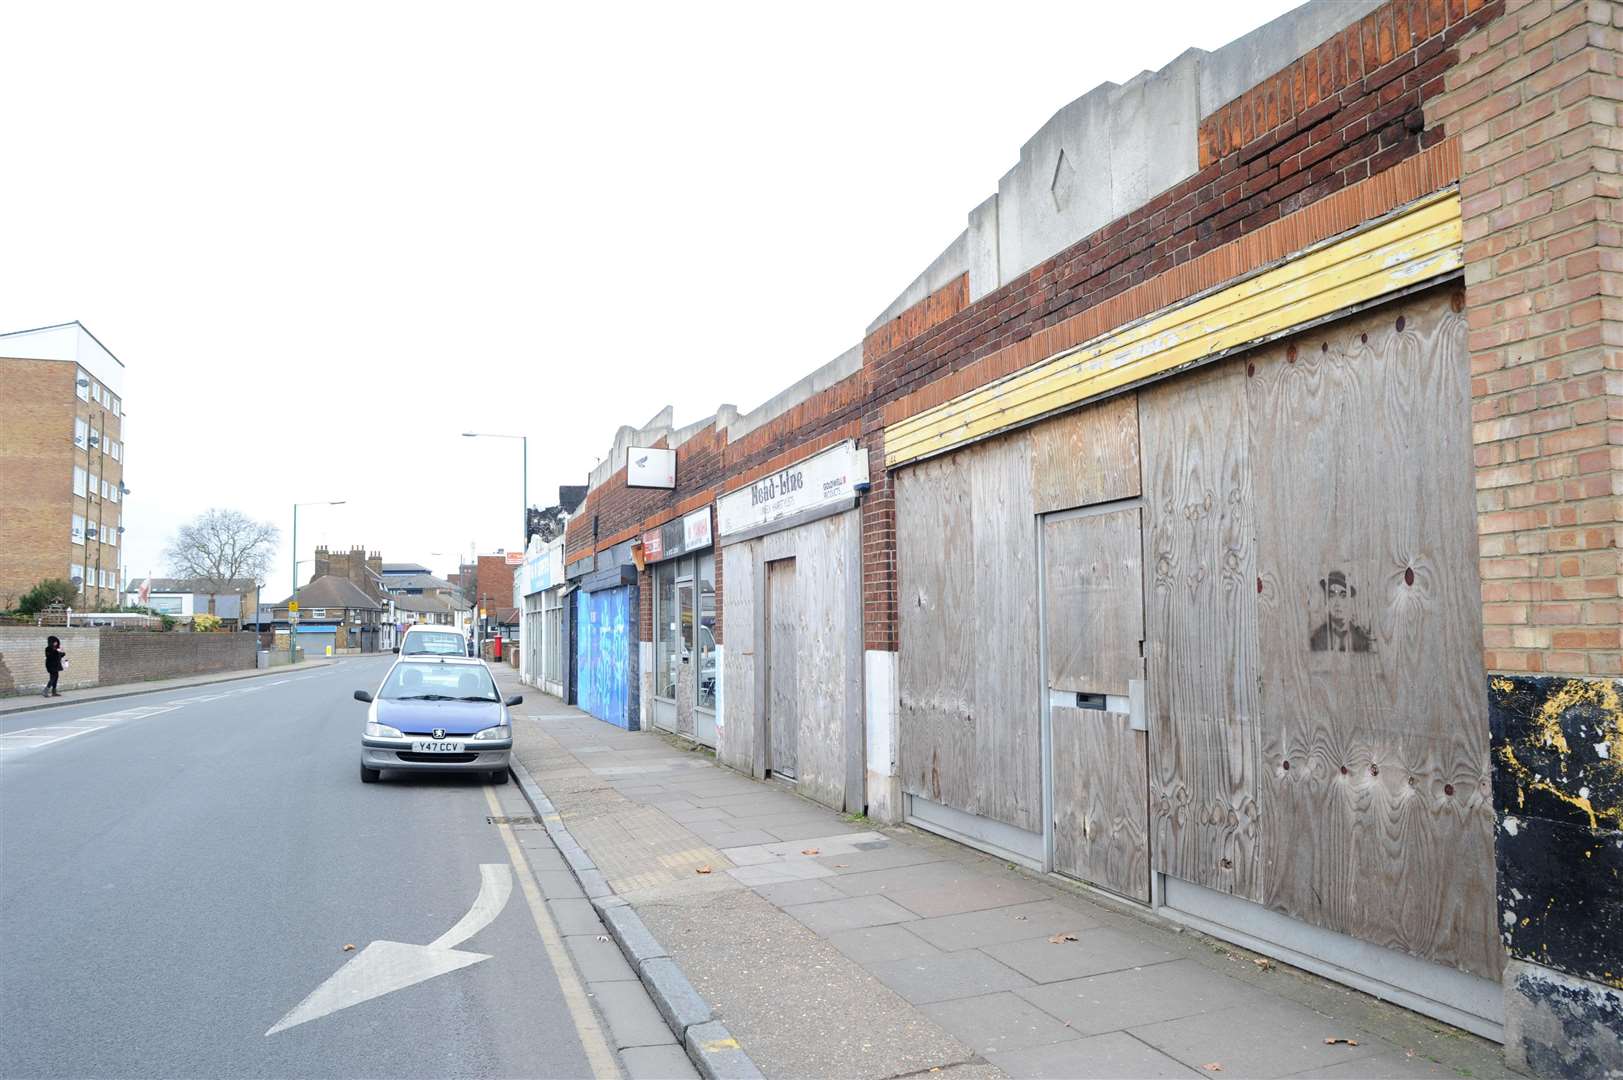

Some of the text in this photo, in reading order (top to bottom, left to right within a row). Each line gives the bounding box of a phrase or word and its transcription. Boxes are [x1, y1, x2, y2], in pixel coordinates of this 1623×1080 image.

[752, 471, 803, 506] Head-Line
[419, 742, 458, 752] Y47 CCV
